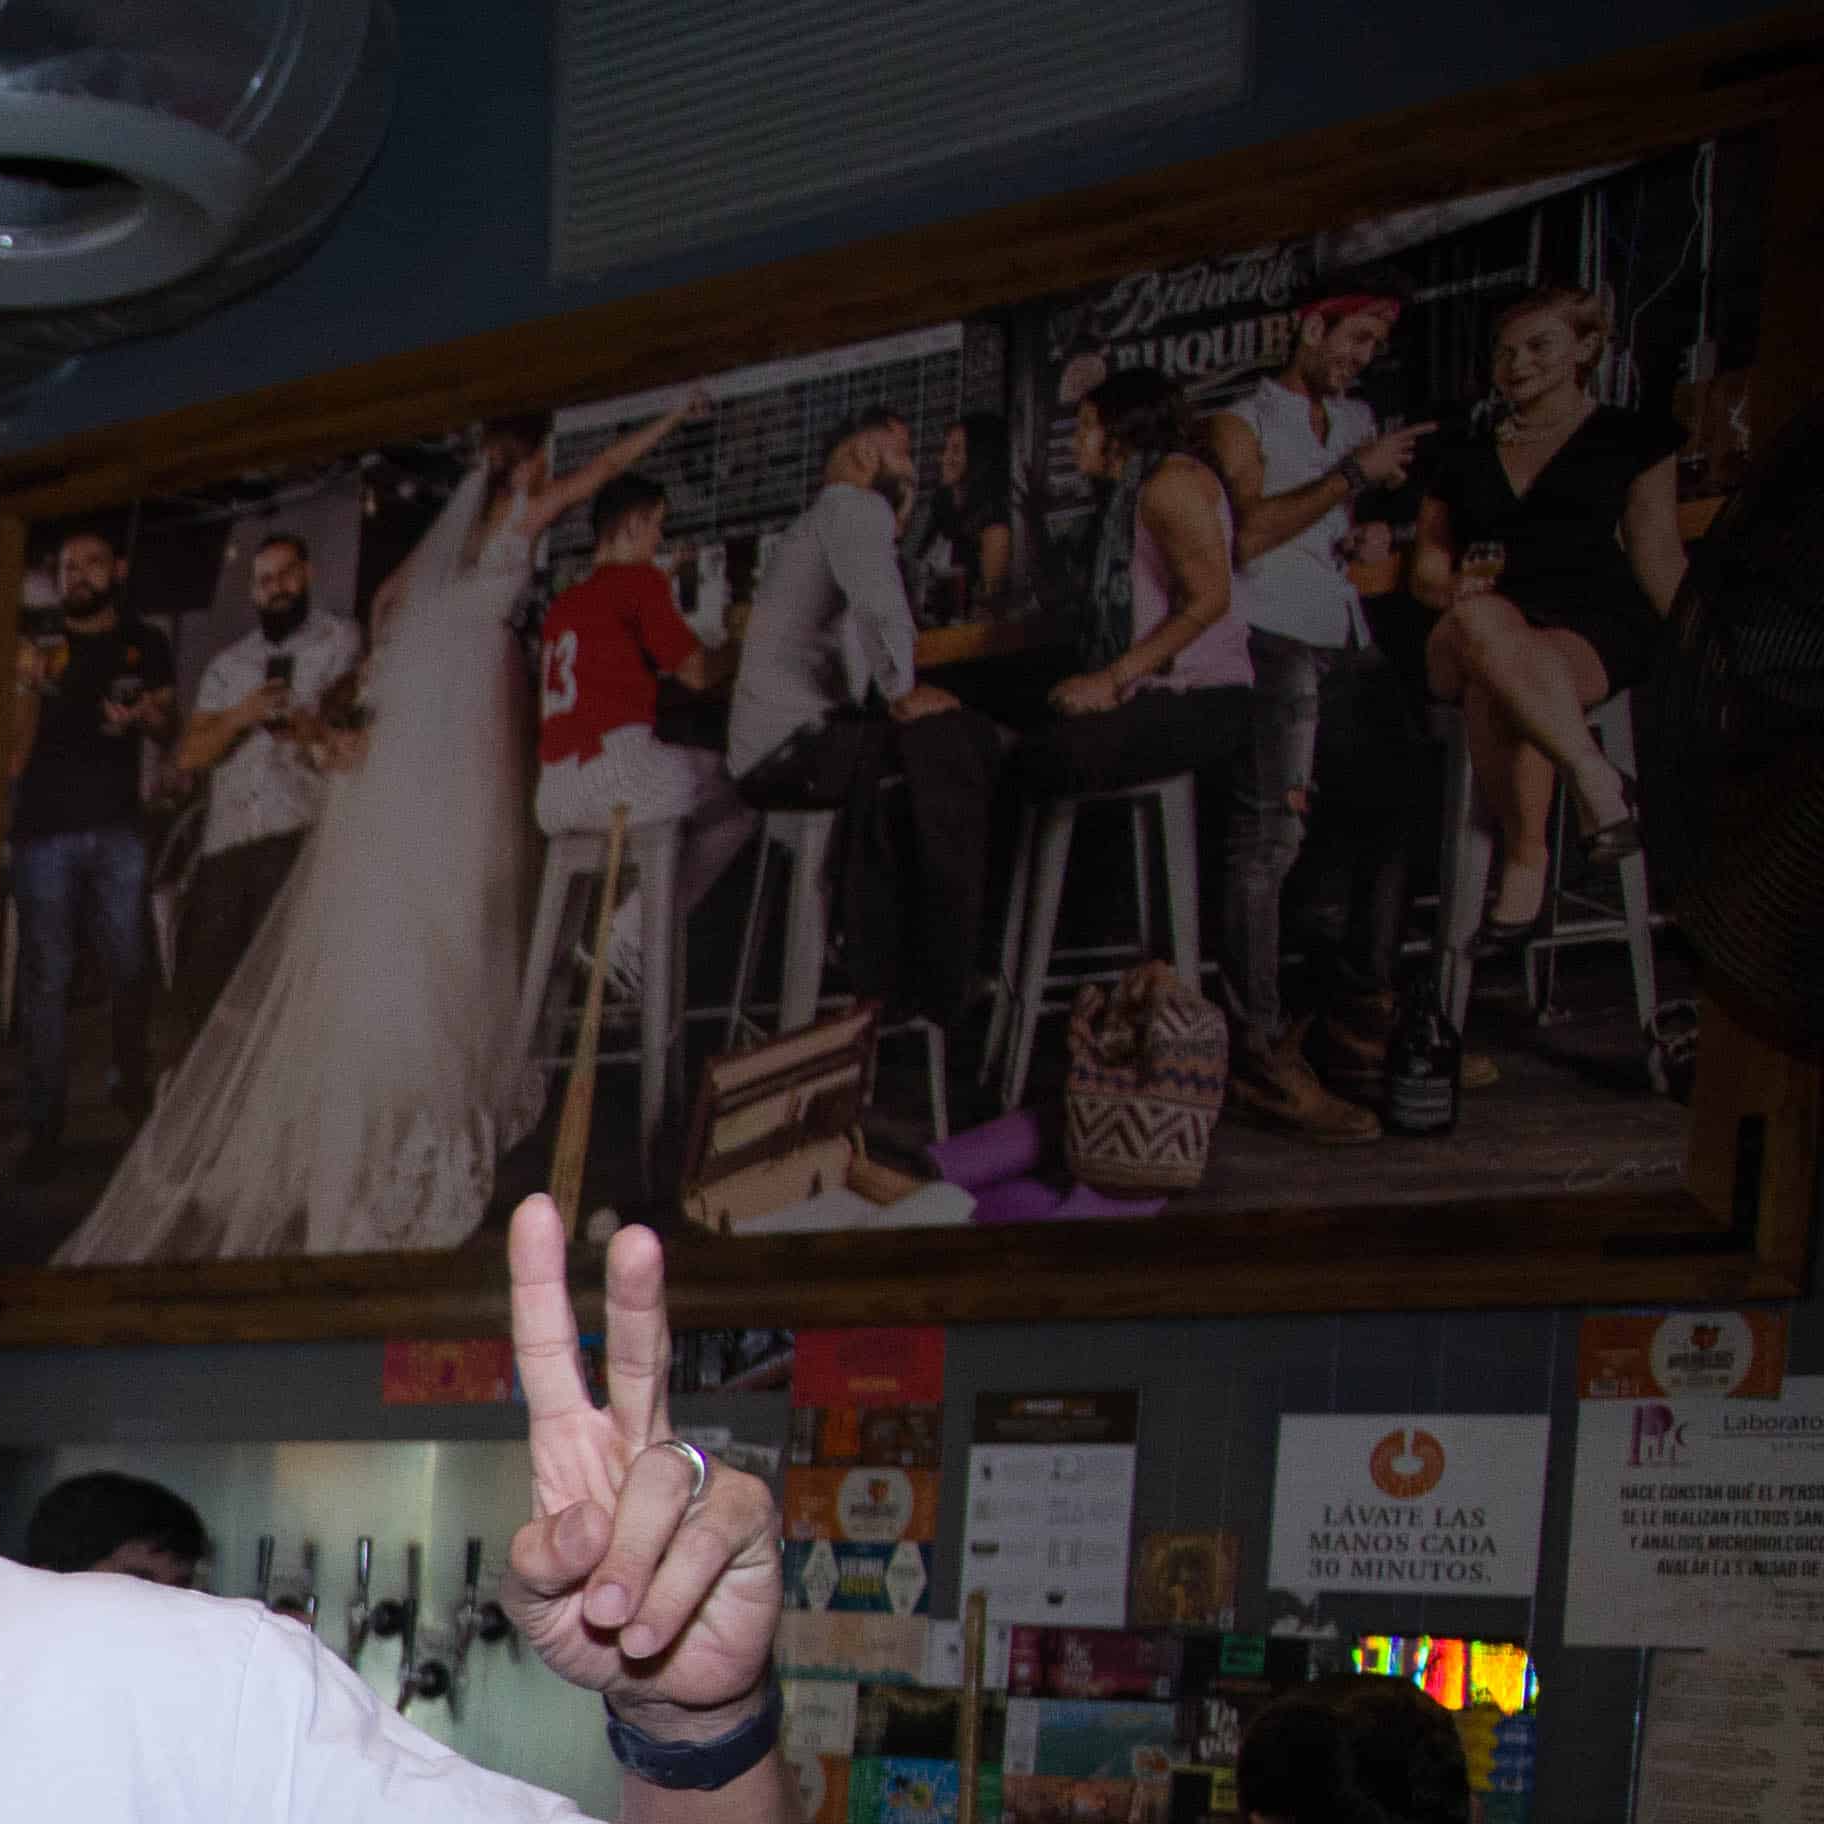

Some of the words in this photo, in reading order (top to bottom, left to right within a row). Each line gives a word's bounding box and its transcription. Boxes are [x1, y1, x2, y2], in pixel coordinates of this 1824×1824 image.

[1434, 1505, 1486, 1530] LAS
[1661, 1509, 1731, 1528] REALIZAN
[1734, 1510, 1790, 1528] FILTROS
[1309, 1530, 1410, 1555] MANOS
[1420, 1533, 1497, 1557] CADA
[1308, 1557, 1340, 1580] 30
